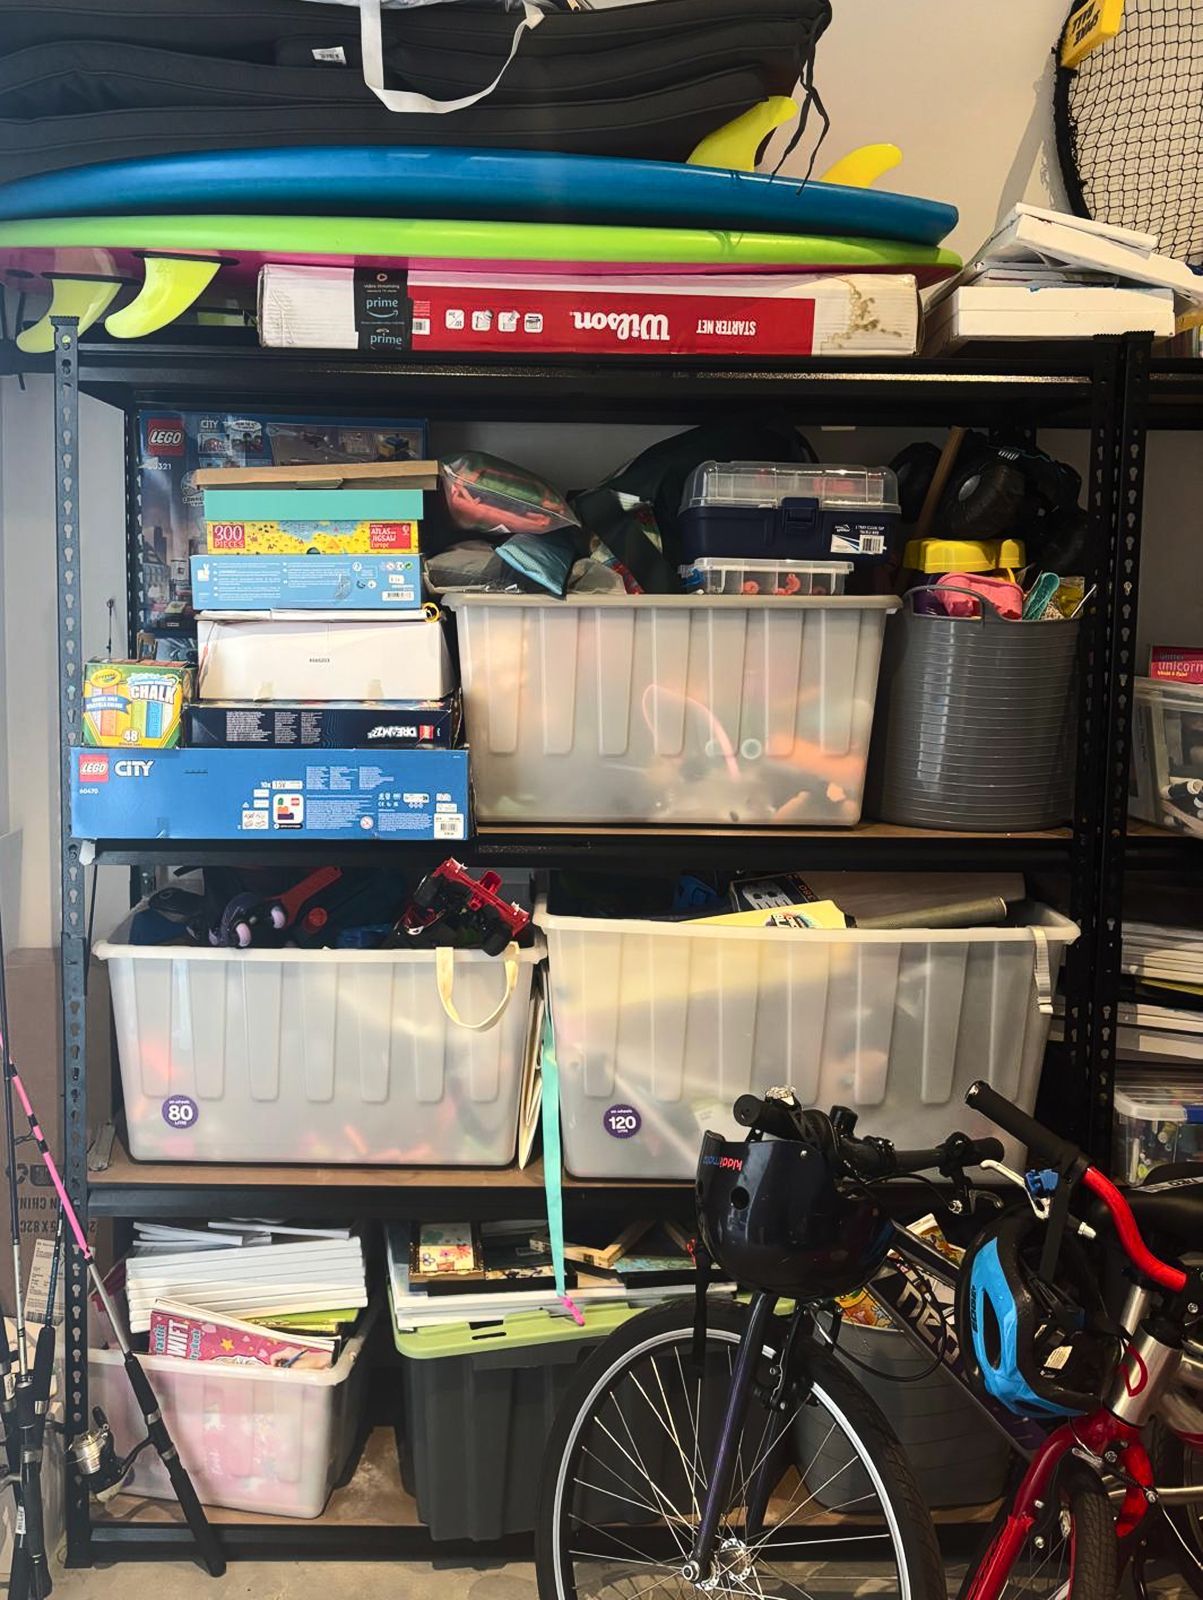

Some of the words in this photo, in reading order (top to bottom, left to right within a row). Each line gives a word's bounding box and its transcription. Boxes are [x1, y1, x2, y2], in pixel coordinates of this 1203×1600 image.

[366, 296, 399, 310] prime
[572, 311, 670, 341] Wilson
[696, 319, 714, 334] NET
[715, 319, 757, 336] STARTER
[370, 332, 402, 345] prime
[200, 419, 219, 429] CITY
[149, 429, 183, 446] LEGO
[213, 525, 243, 541] 300
[131, 684, 175, 705] CHALK
[122, 729, 141, 743] 48
[80, 762, 107, 775] LEGO
[114, 760, 154, 777] CITY
[168, 1104, 193, 1121] 80
[608, 1116, 637, 1130] 120
[166, 1319, 189, 1357] WIFT
